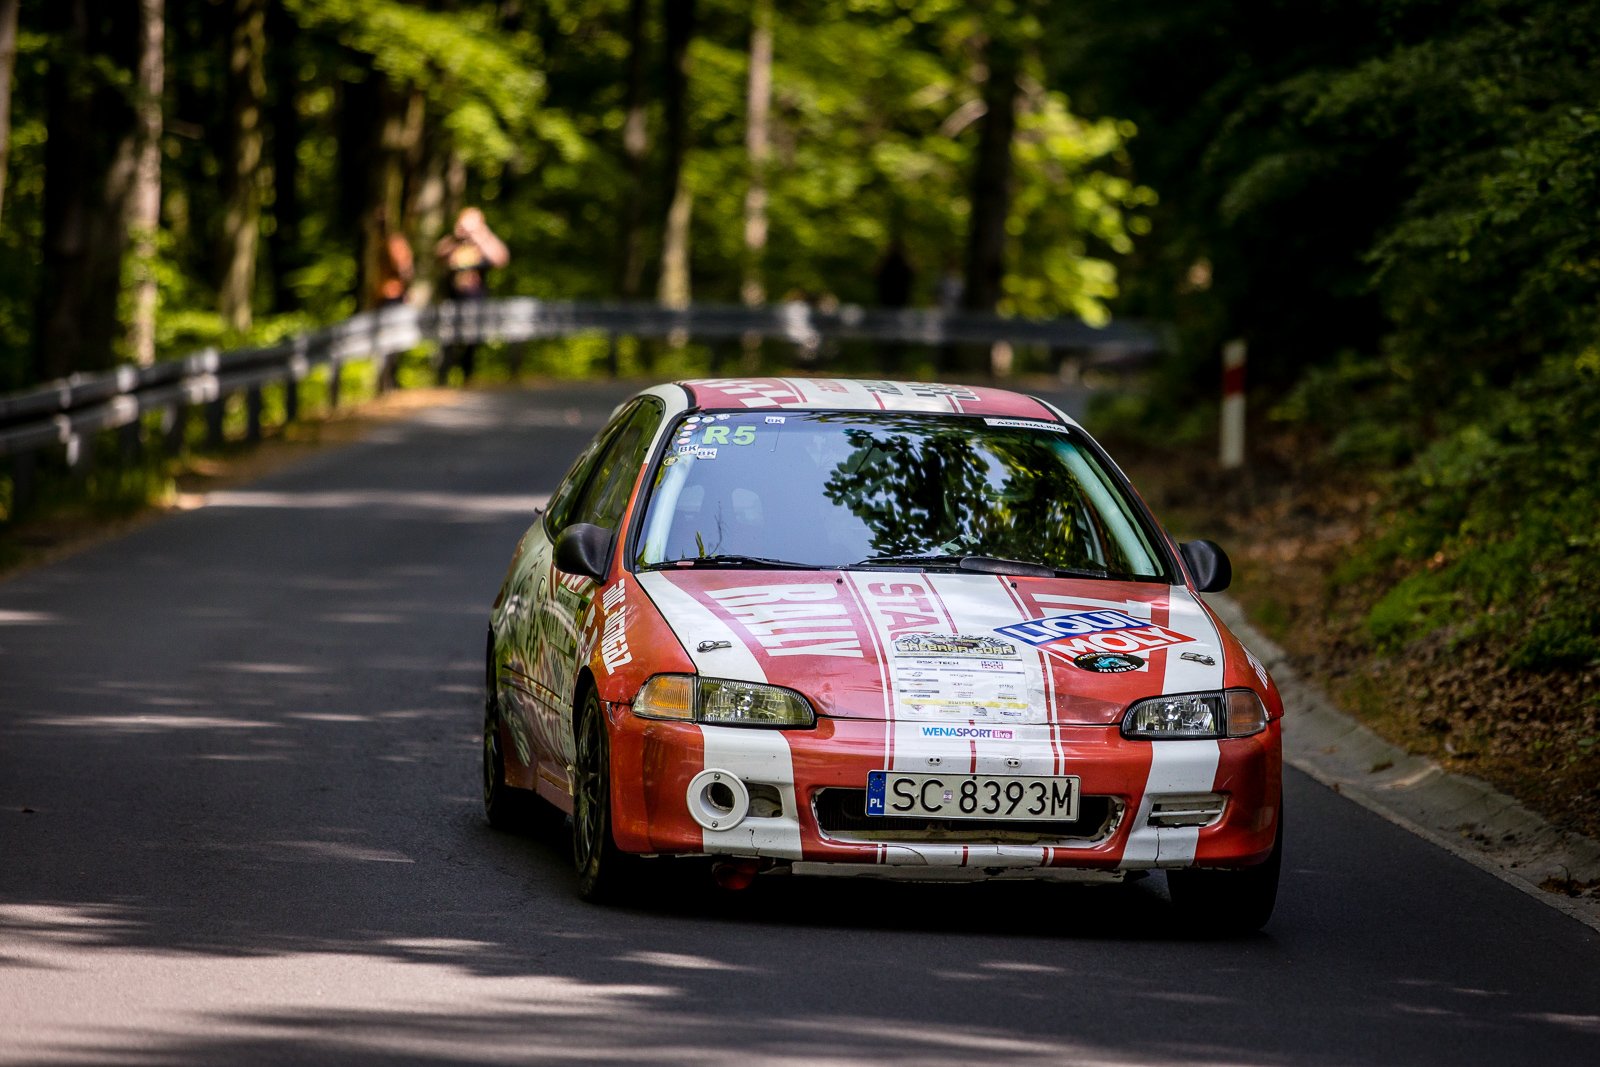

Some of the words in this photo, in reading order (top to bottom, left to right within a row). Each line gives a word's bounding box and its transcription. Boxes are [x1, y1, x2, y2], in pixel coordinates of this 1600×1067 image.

[702, 425, 756, 446] R5
[680, 445, 697, 453] BK
[703, 583, 864, 658] RALLY
[1002, 610, 1143, 644] LIQUI
[1049, 627, 1175, 659] MOLY
[922, 726, 991, 738] WENASPORT
[993, 730, 1011, 739] live
[869, 798, 883, 809] PL
[891, 777, 945, 813] SC
[958, 779, 1073, 817] 8393M
